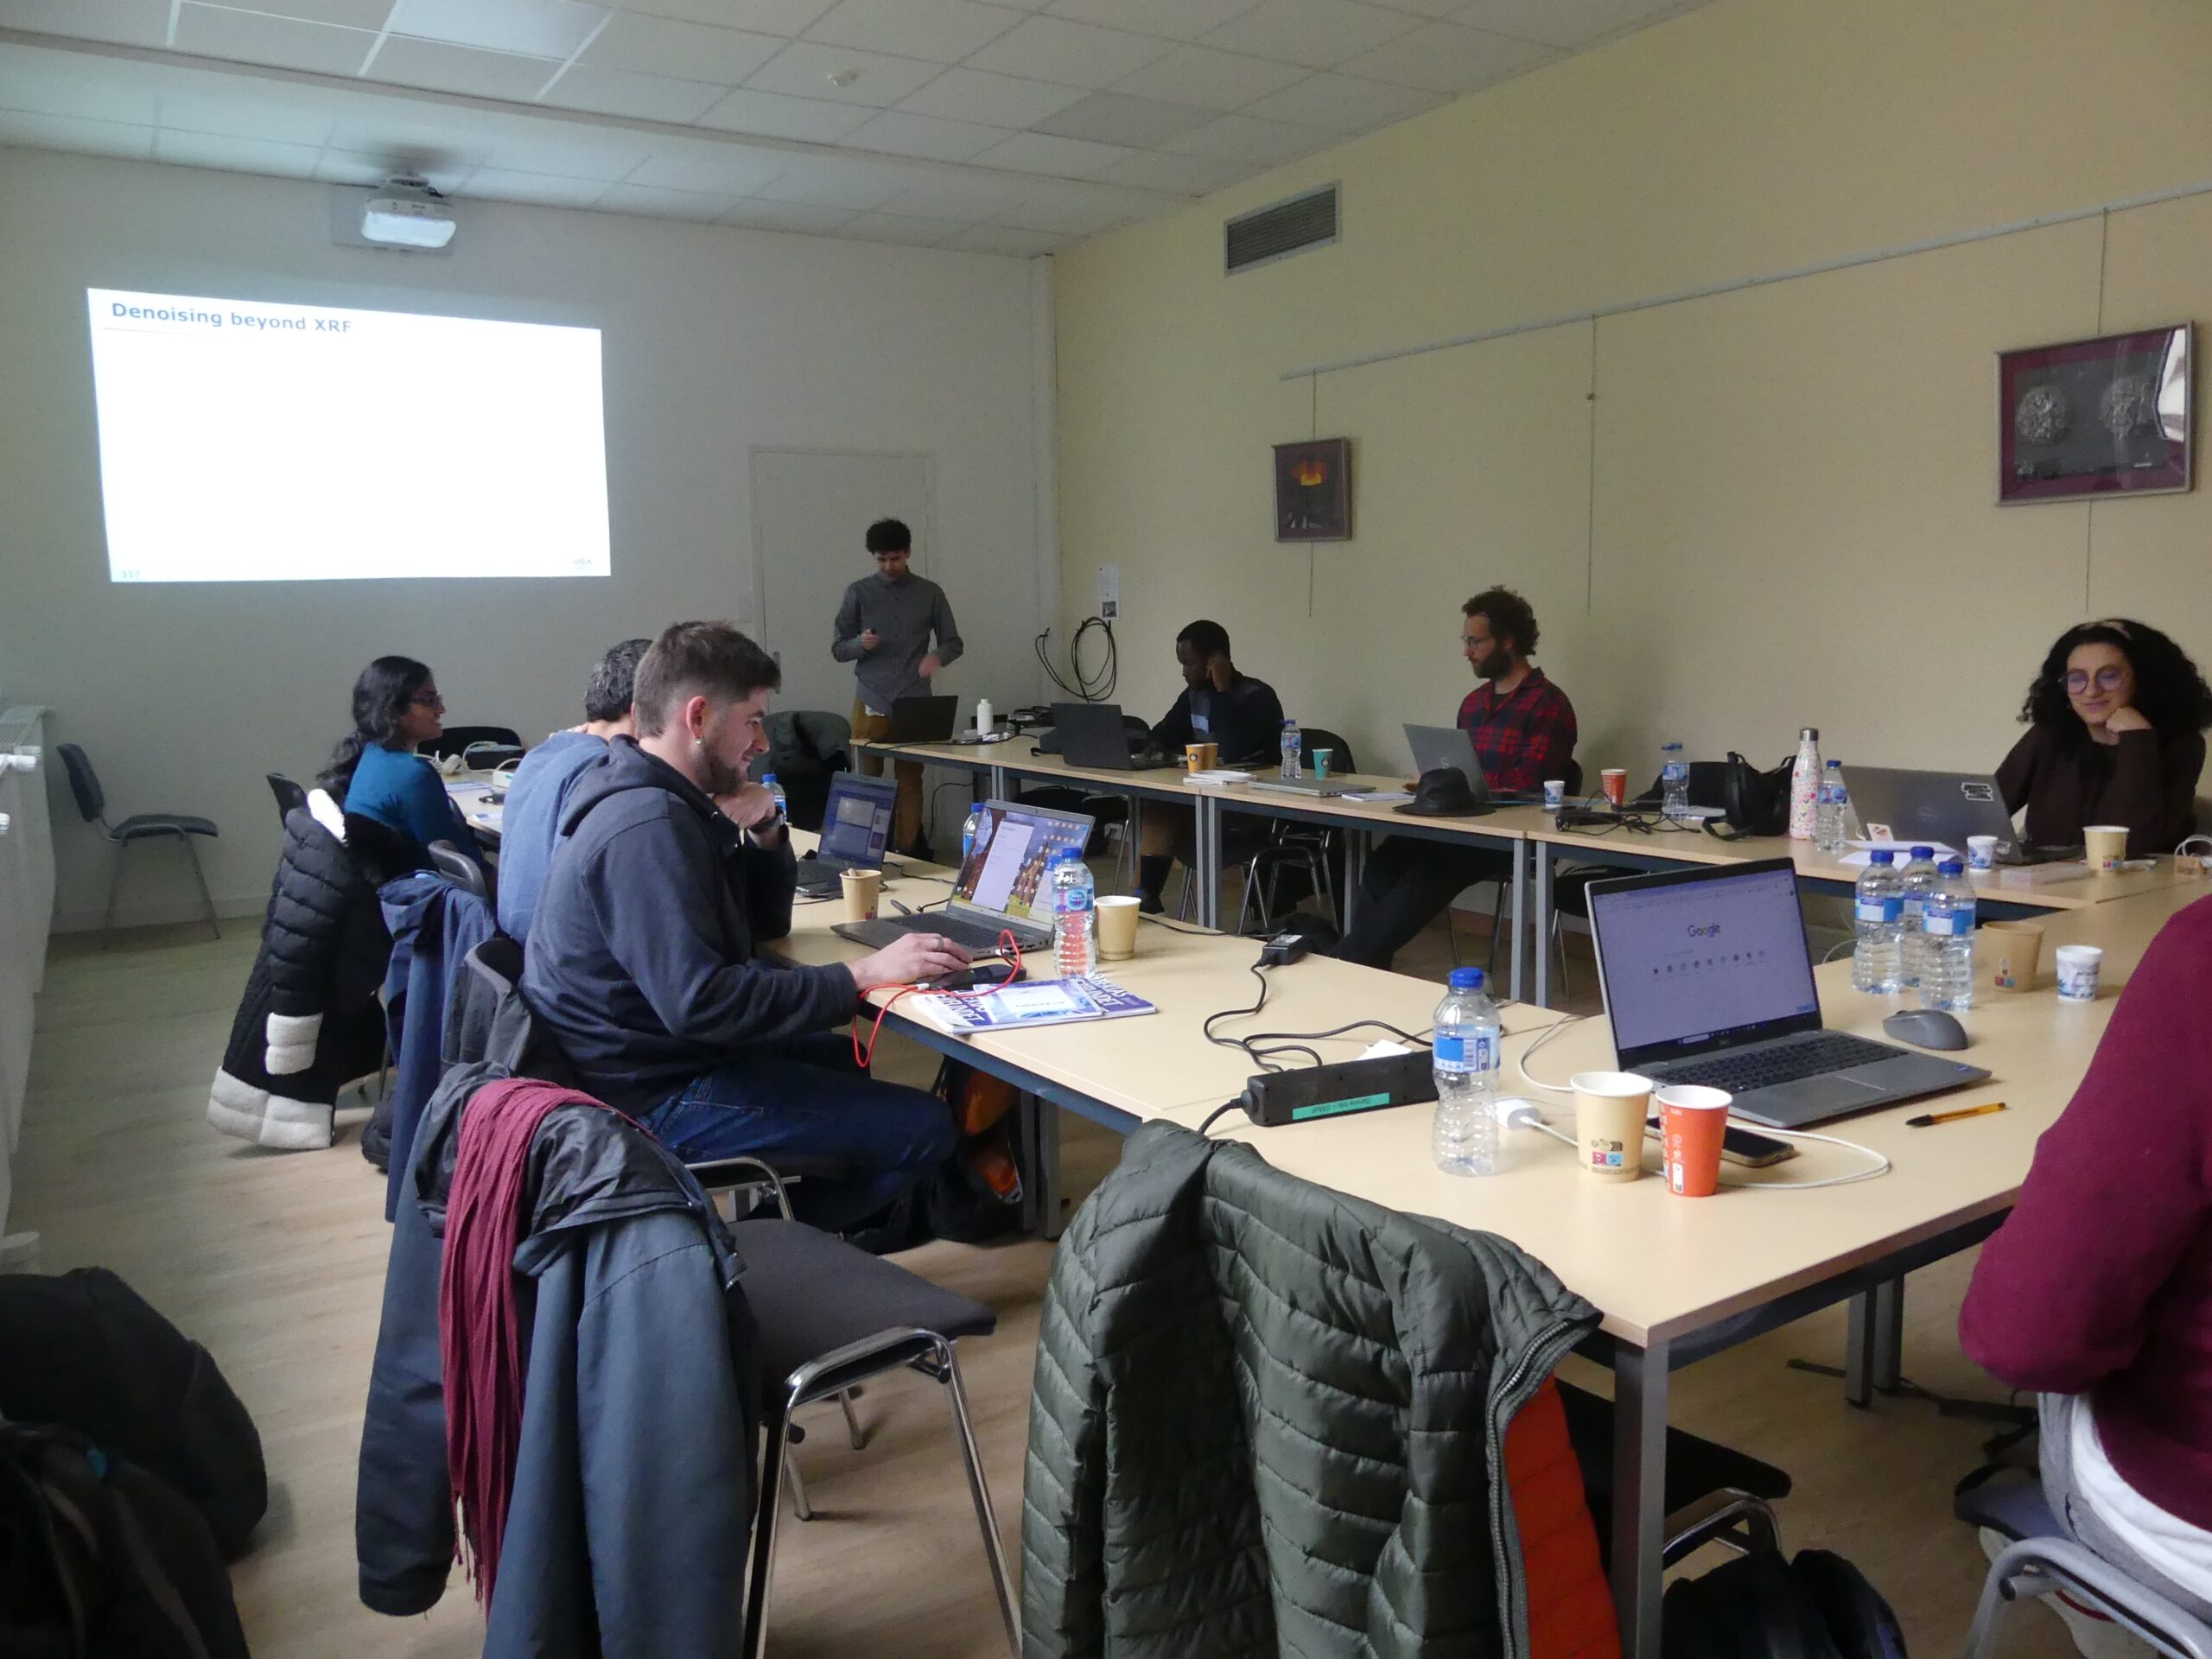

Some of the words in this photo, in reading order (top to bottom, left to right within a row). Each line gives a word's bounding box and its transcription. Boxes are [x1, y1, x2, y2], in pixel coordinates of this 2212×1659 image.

[111, 302, 222, 327] Denoising
[231, 312, 306, 330] beyond
[315, 318, 352, 332] XRF
[1688, 923, 1721, 938] Google
